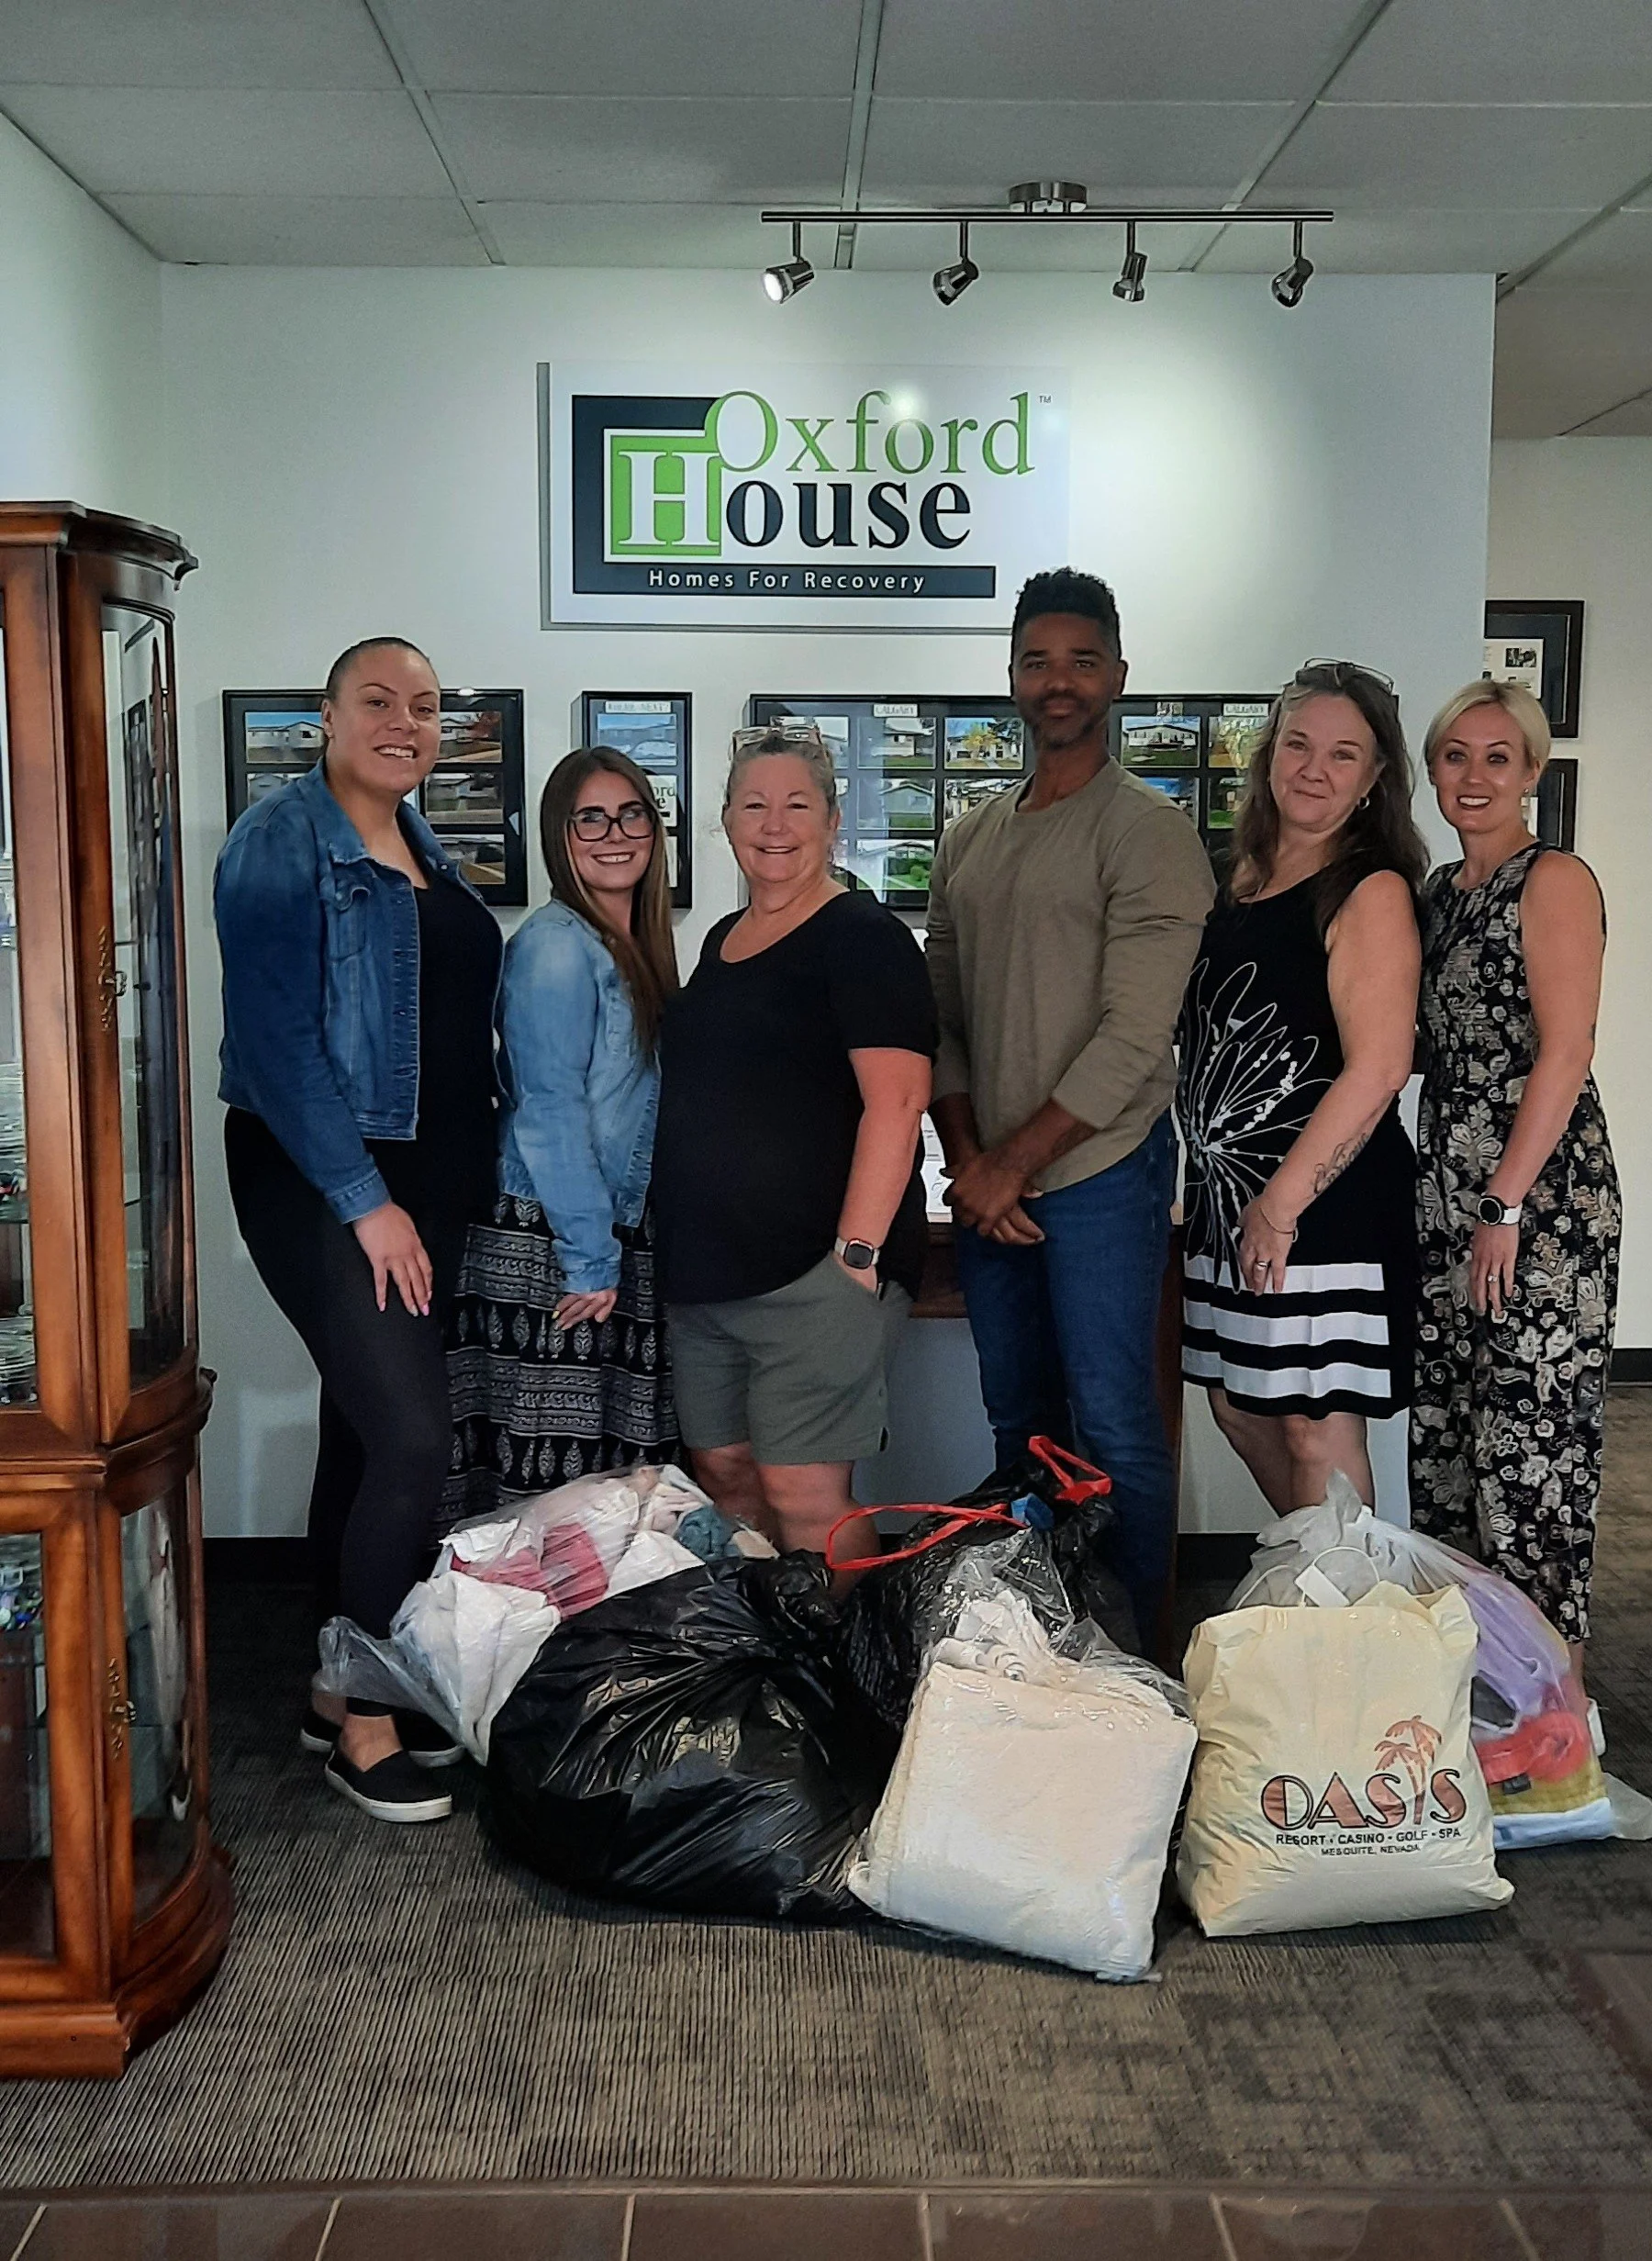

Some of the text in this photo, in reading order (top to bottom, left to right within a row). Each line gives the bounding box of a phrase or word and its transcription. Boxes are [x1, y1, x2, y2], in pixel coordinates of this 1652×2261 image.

[703, 390, 1036, 476] Oxford
[618, 450, 972, 550] House
[648, 569, 925, 594] Homes For Recovery
[1260, 1768, 1468, 1830] OASIS
[1276, 1828, 1462, 1846] RESORT CASINO GOLF SPA
[1379, 1844, 1422, 1854] NEVADA
